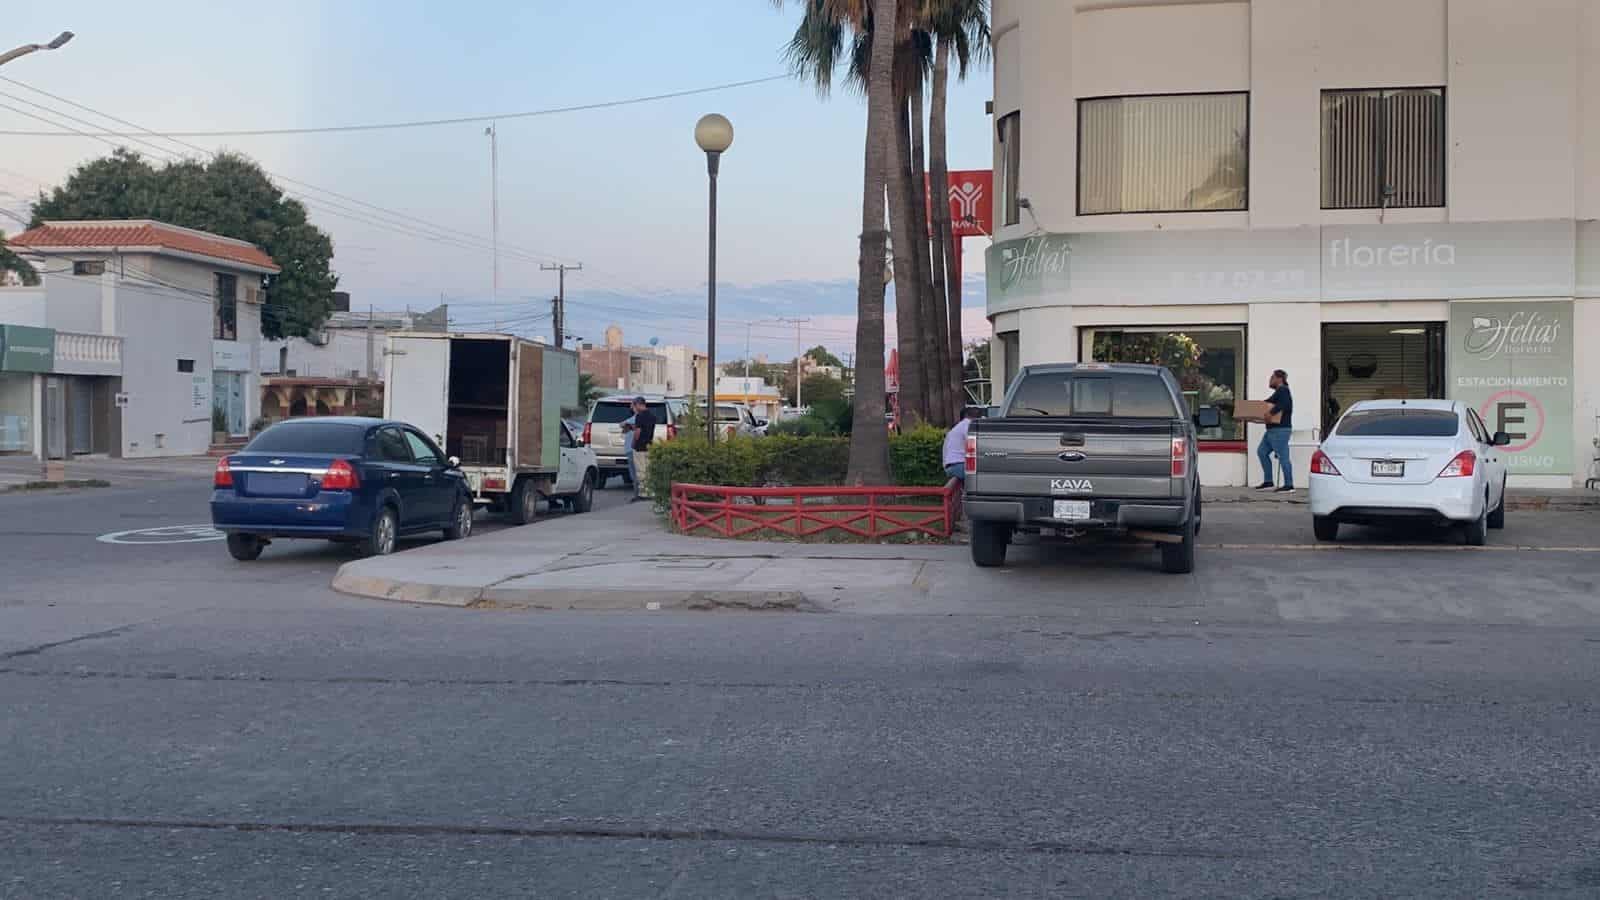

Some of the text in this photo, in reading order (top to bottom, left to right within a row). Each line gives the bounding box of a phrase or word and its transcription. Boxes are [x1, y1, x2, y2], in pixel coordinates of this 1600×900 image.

[1329, 238, 1456, 267] florería
[1457, 376, 1568, 386] ESTACIONAMIENTO
[1497, 401, 1527, 440] E
[1508, 455, 1554, 466] USIVO
[1050, 479, 1093, 489] KAVA
